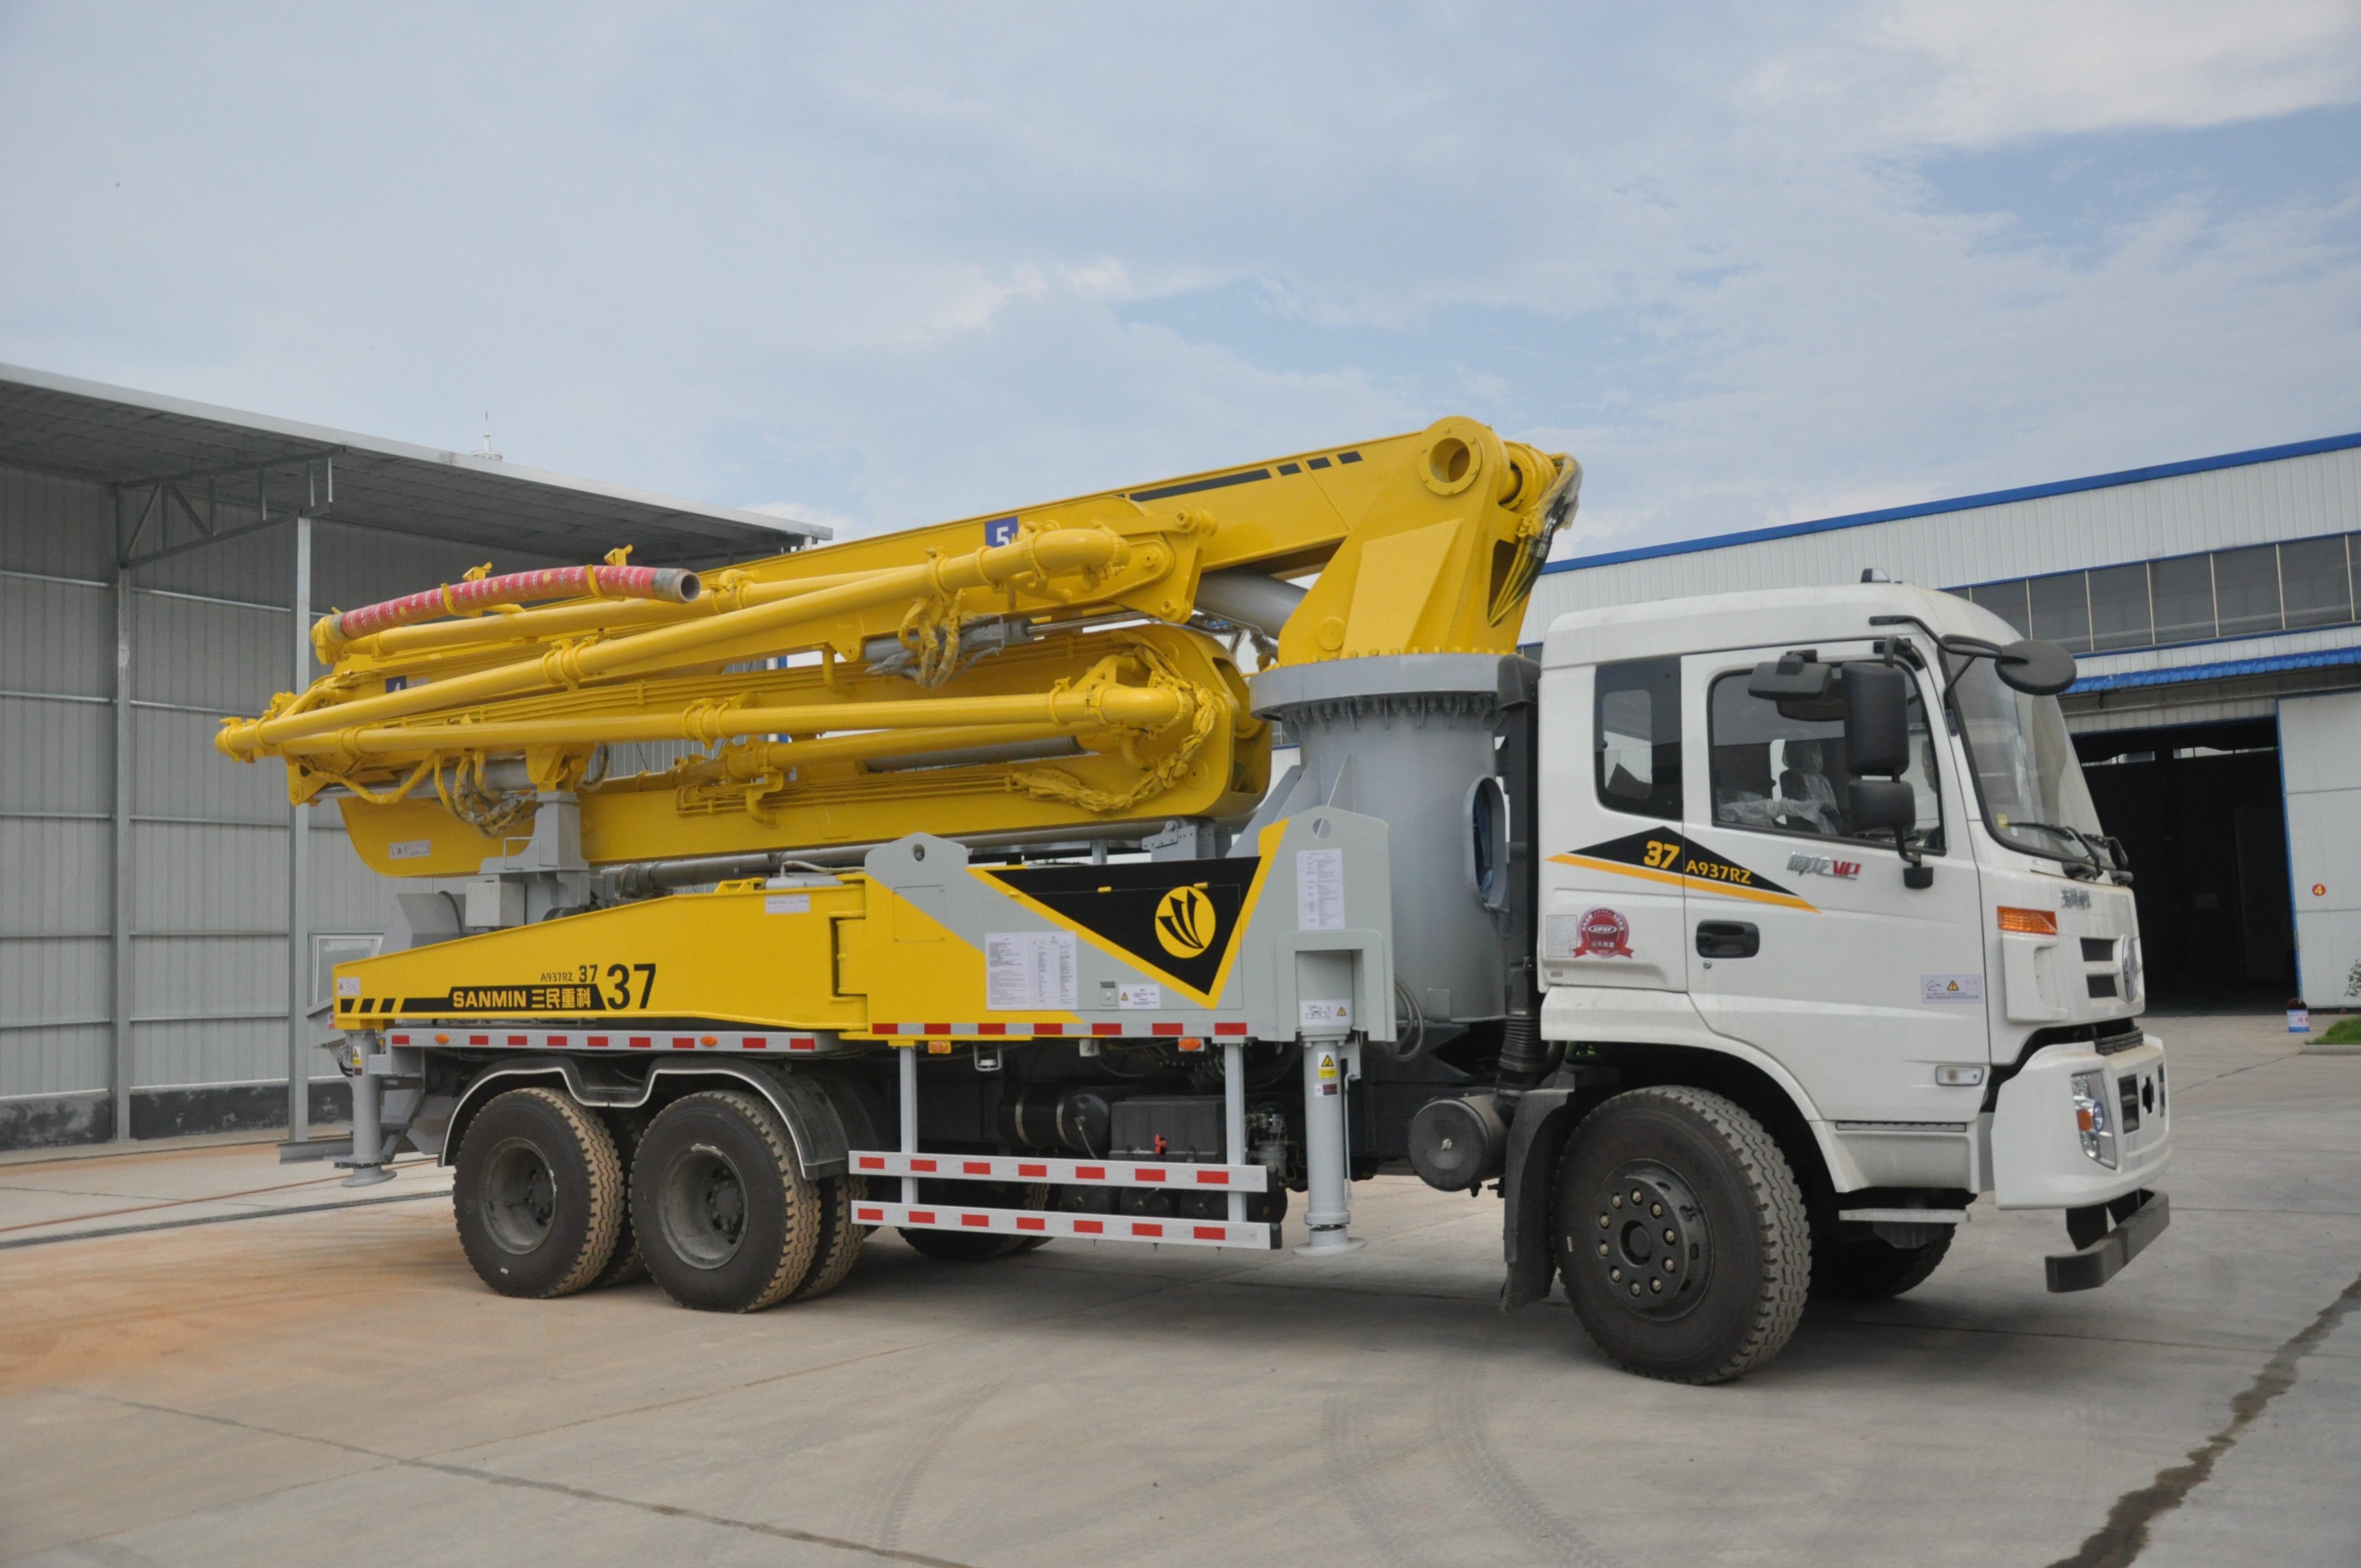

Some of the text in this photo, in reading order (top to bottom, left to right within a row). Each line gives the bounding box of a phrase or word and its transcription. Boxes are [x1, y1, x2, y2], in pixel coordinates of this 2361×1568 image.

[997, 526, 1010, 546] 5
[1644, 840, 1751, 885] 37 A937RZ
[2315, 885, 2322, 895] 4
[540, 964, 598, 983] A937RZ 37
[607, 963, 656, 1010] 37
[453, 987, 591, 1009] SANMIN 三民重科
